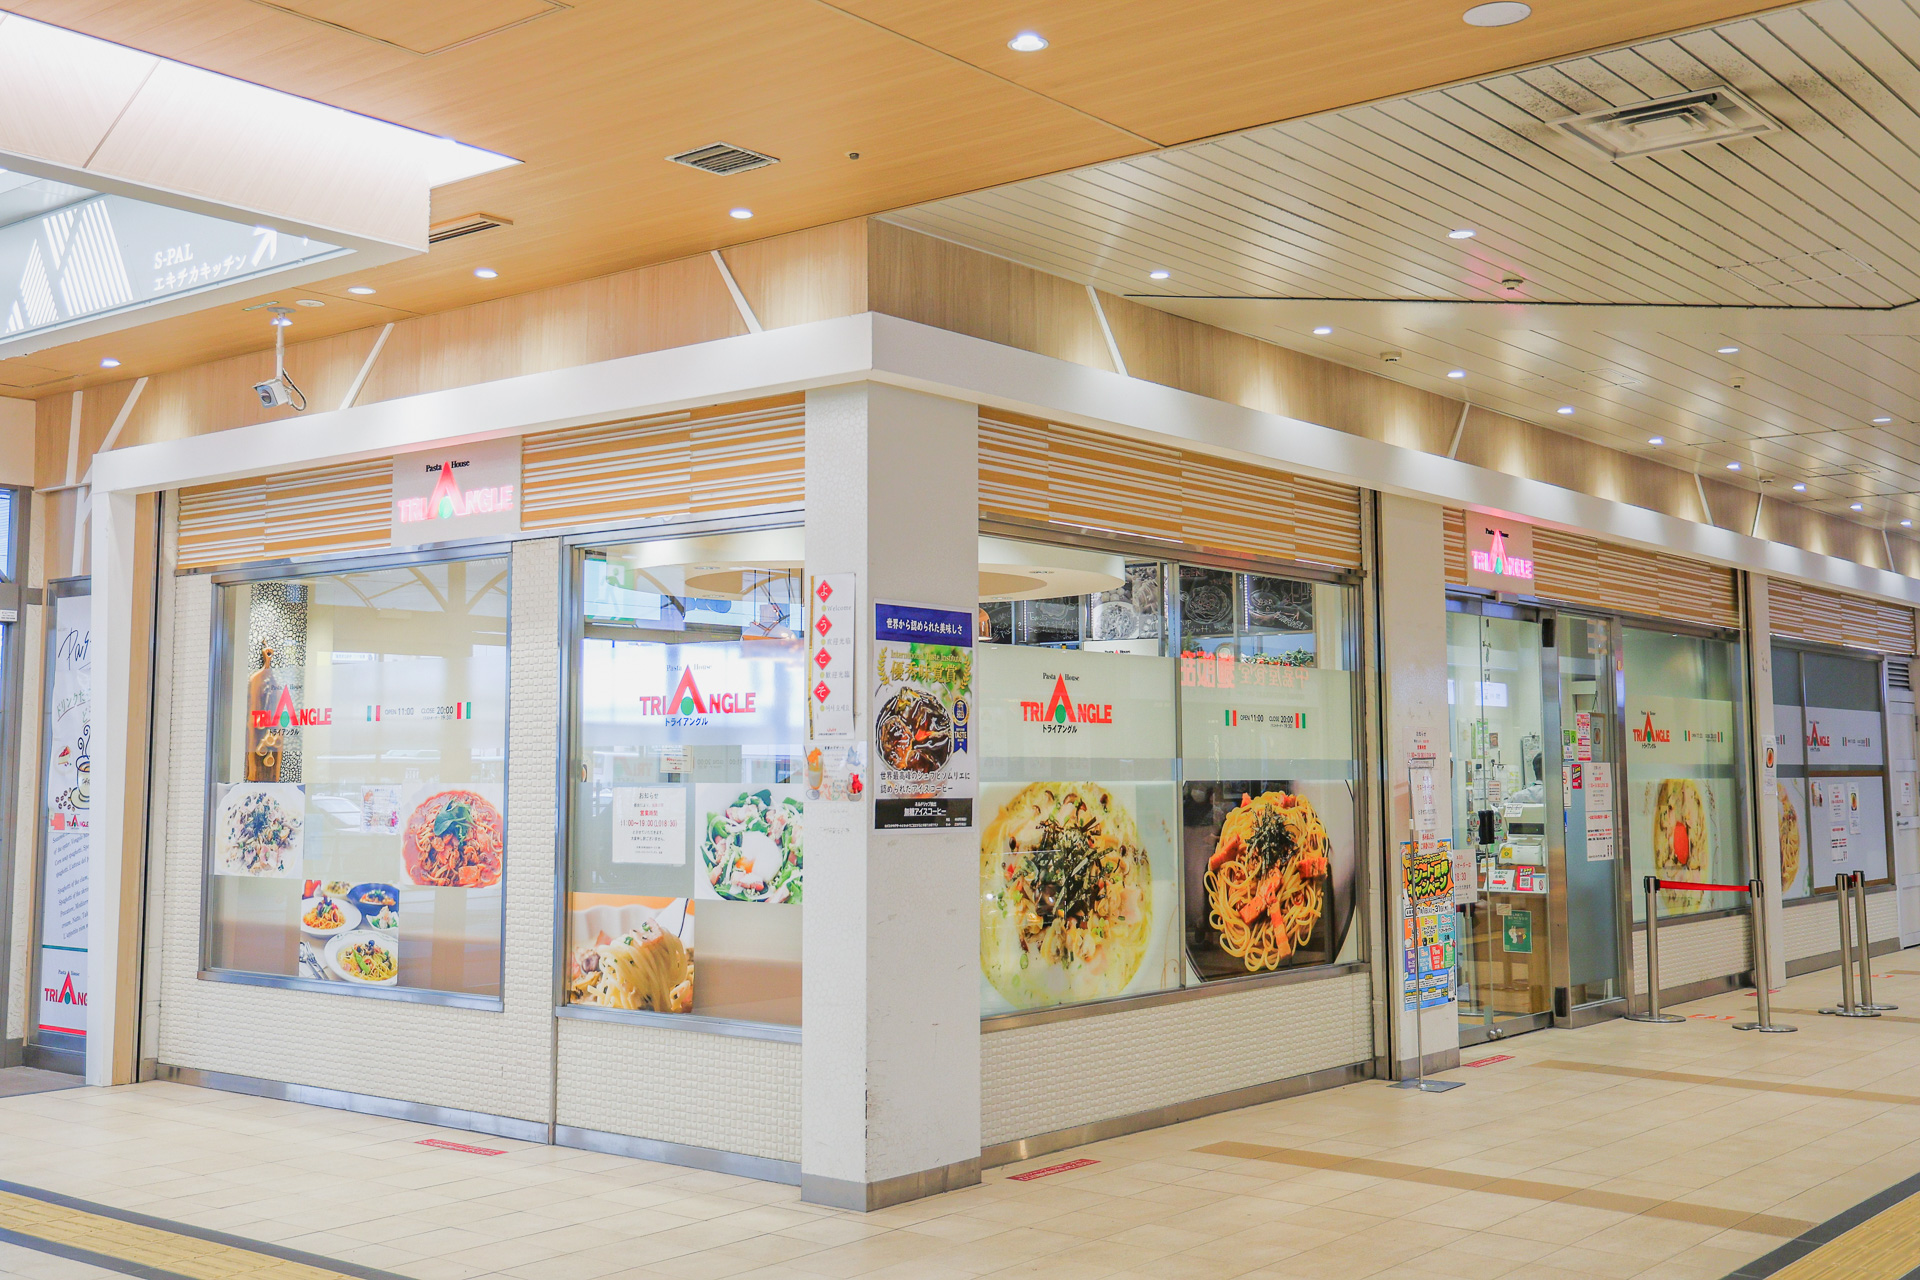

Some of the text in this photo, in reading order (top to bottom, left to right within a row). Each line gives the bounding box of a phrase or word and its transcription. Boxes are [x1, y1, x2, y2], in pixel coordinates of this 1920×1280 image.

[153, 243, 194, 269] S-PAL
[153, 254, 247, 291] エキチカキッチン
[425, 460, 470, 472] Pasta House
[397, 461, 515, 524] TRIANGLE
[1471, 529, 1534, 579] TRIANGLE
[886, 617, 963, 635] 世界から認められた美味しさ
[57, 627, 92, 671] Pas
[890, 660, 958, 684] 優秀味覚賞
[1042, 672, 1079, 681] Pasta House
[639, 664, 756, 716] TRIANGLE
[1020, 673, 1112, 724] TRIANGLE
[251, 684, 332, 729] TRIANGLE
[398, 707, 415, 716] 11:00
[437, 705, 454, 715] 20:00
[665, 717, 708, 727] トライアングル
[1250, 714, 1264, 722] 11:00
[1280, 715, 1294, 724] 20:00
[1632, 711, 1670, 743] TRIANGLE
[269, 728, 300, 736] トライアングル
[1042, 724, 1078, 734] トライアングル
[880, 771, 971, 780] 世界最高峰のシェフとソムリエに
[639, 792, 659, 800] お知らせ
[880, 784, 953, 794] 認められたアイスコーヒー
